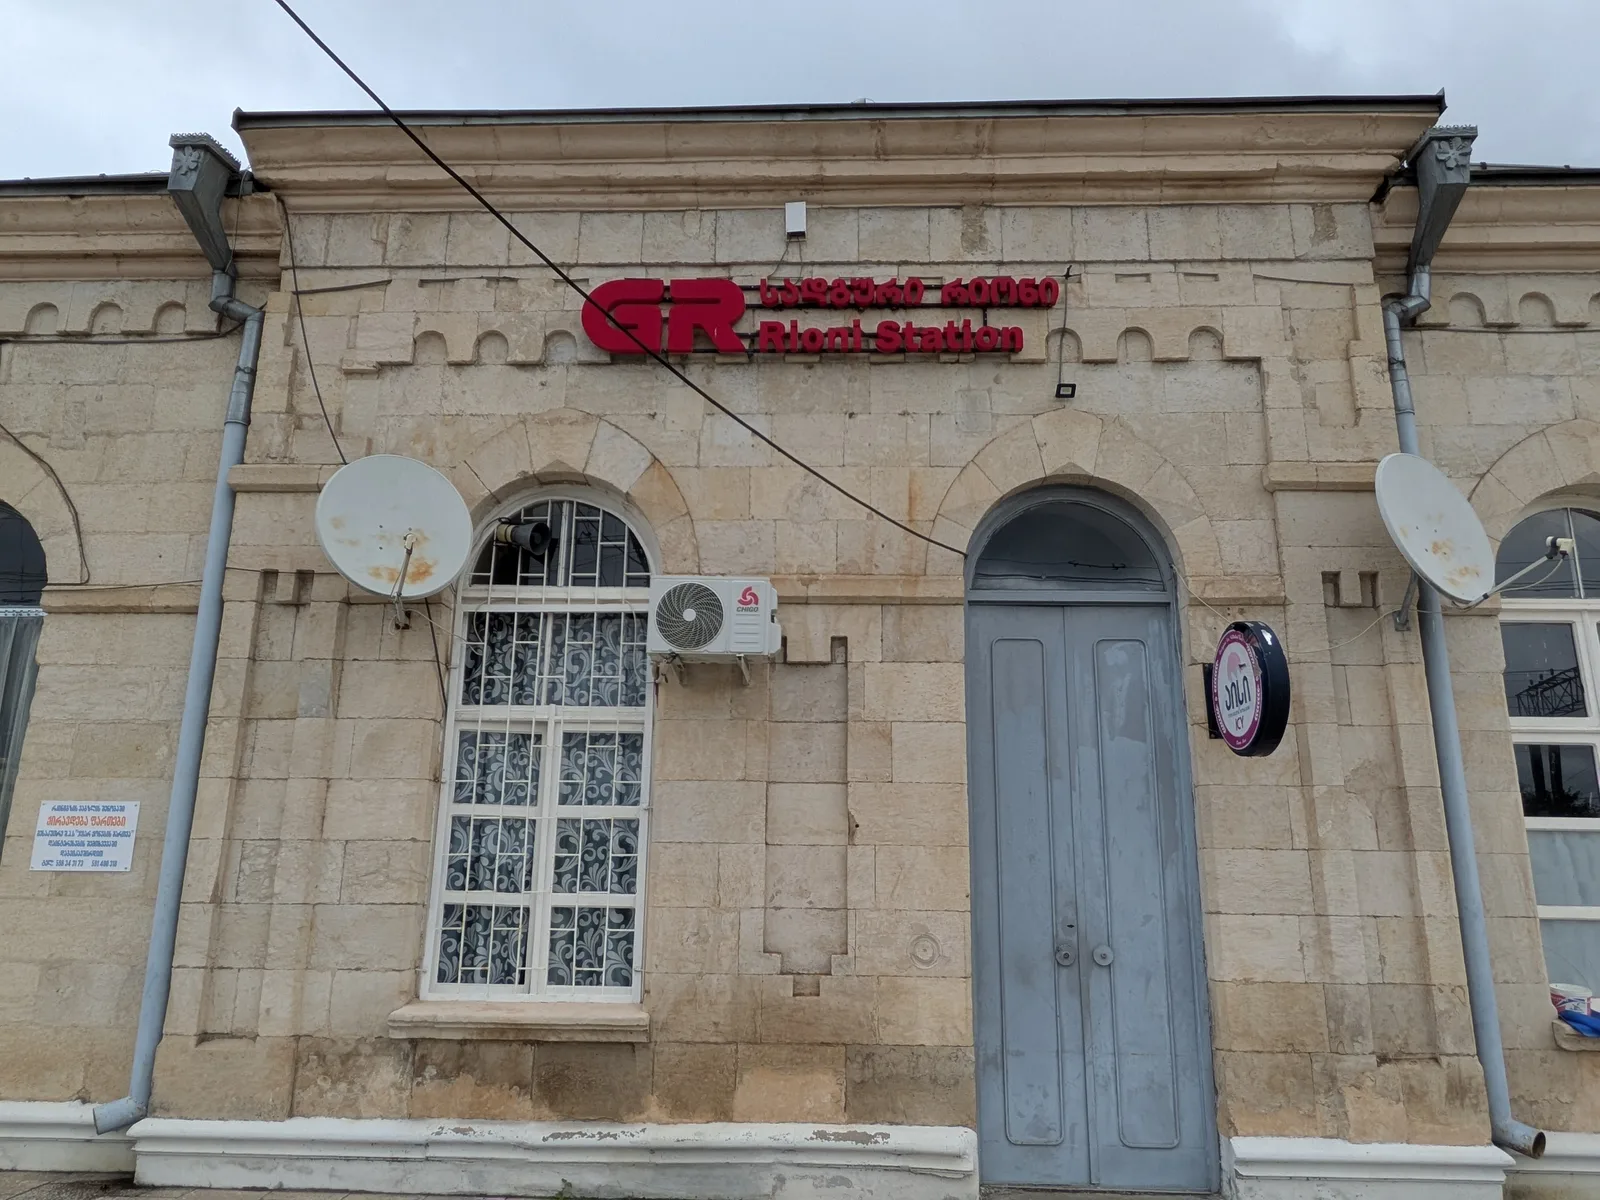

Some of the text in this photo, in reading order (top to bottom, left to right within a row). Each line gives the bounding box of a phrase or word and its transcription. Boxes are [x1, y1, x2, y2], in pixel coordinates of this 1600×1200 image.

[759, 277, 1060, 307] სადგური რიონი
[758, 320, 1024, 353] Rioni Station
[90, 816, 126, 826] ფართები
